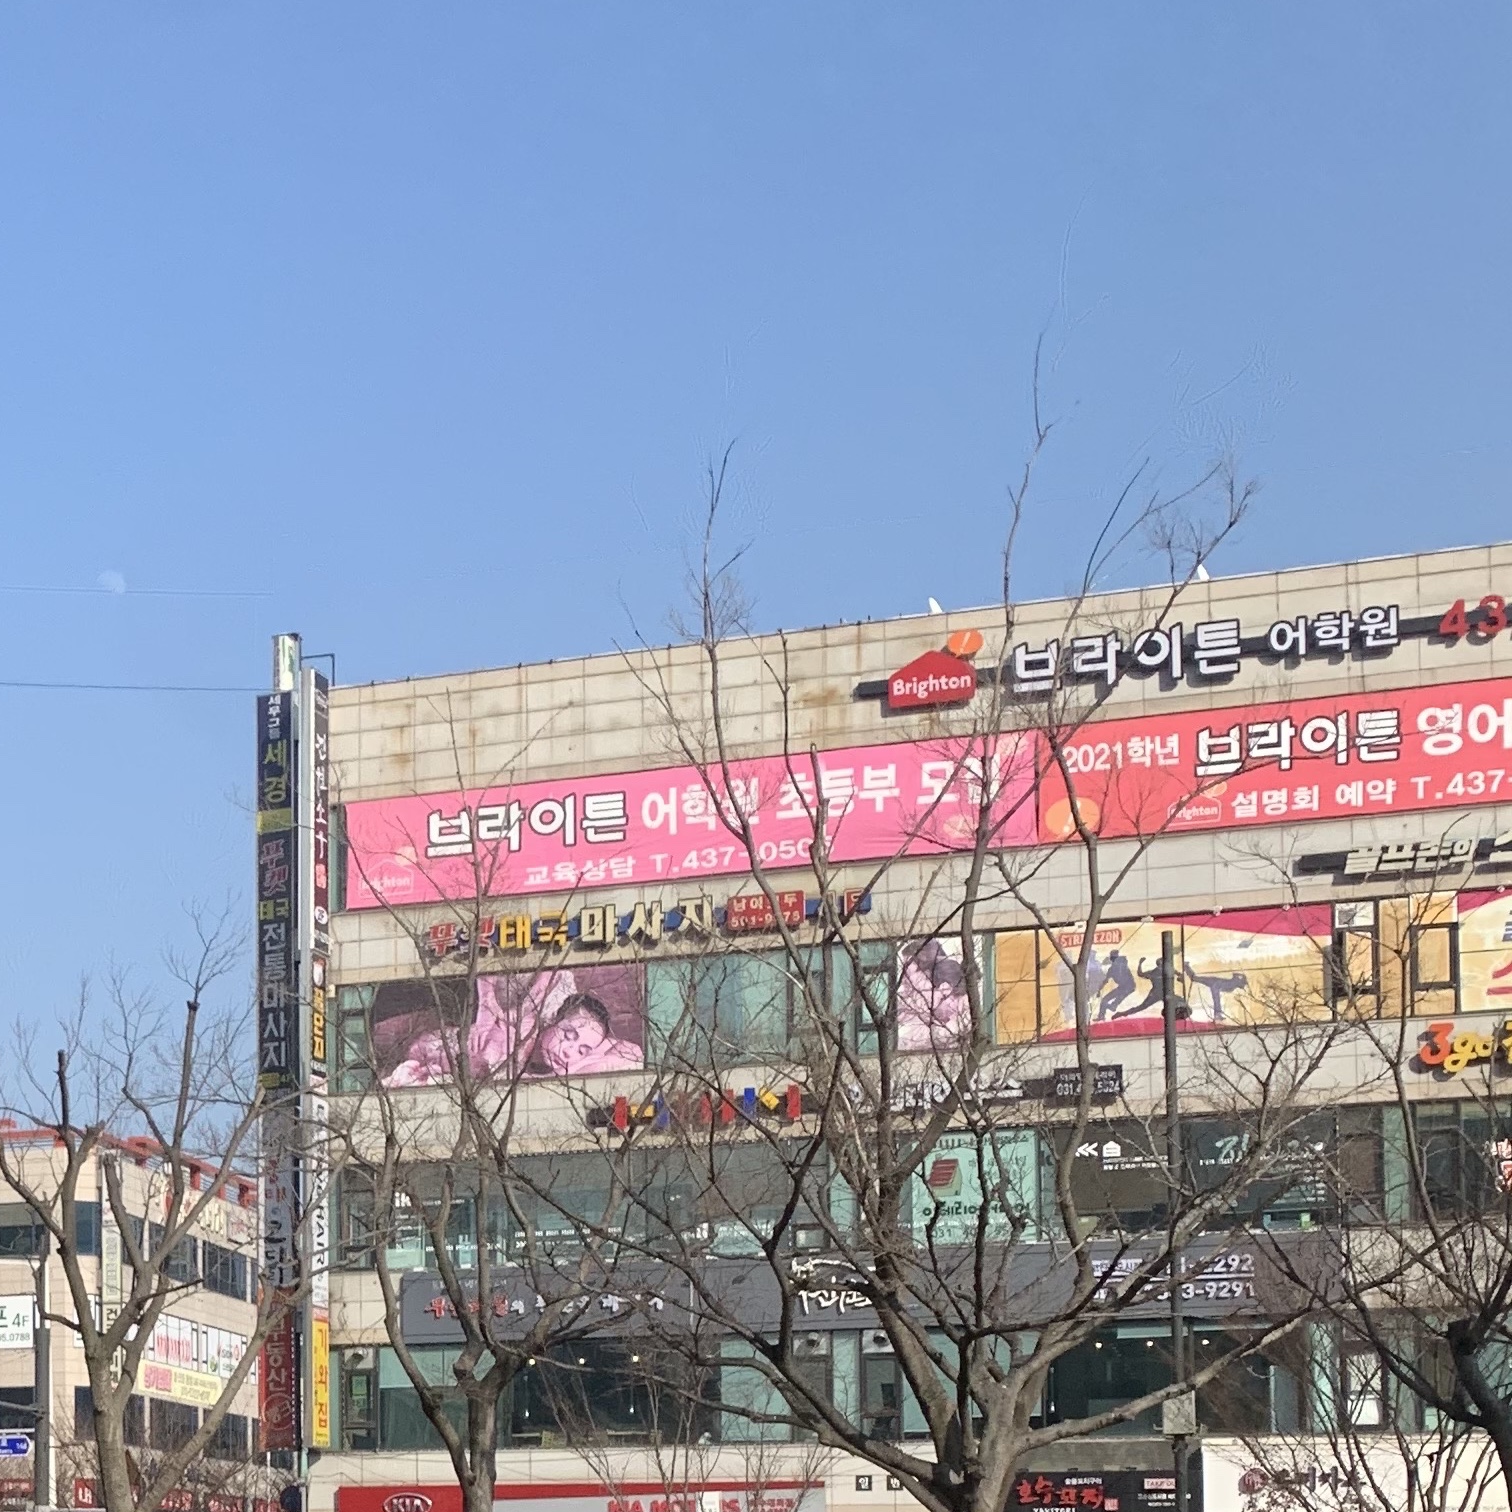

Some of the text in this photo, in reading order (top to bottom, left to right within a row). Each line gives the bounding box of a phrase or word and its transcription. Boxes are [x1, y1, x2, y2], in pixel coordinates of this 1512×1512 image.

[1012, 618, 1242, 694] 브라이튼
[1268, 604, 1400, 656] 어학원
[892, 674, 972, 699] Brighton
[1062, 697, 1512, 777] 2021학년 브라이튼 영어
[263, 739, 288, 801] 세경
[425, 790, 628, 858] 브라이튼
[640, 776, 760, 836] 어학원
[775, 761, 901, 823] 초등부
[1231, 783, 1320, 819] 설명회
[1335, 777, 1398, 807] 예약
[523, 856, 635, 887] 교육상담
[579, 893, 714, 944] 마사지
[732, 893, 798, 913] 남여두
[261, 921, 289, 1071] 전통마사지
[11, 1312, 30, 1329] 4F
